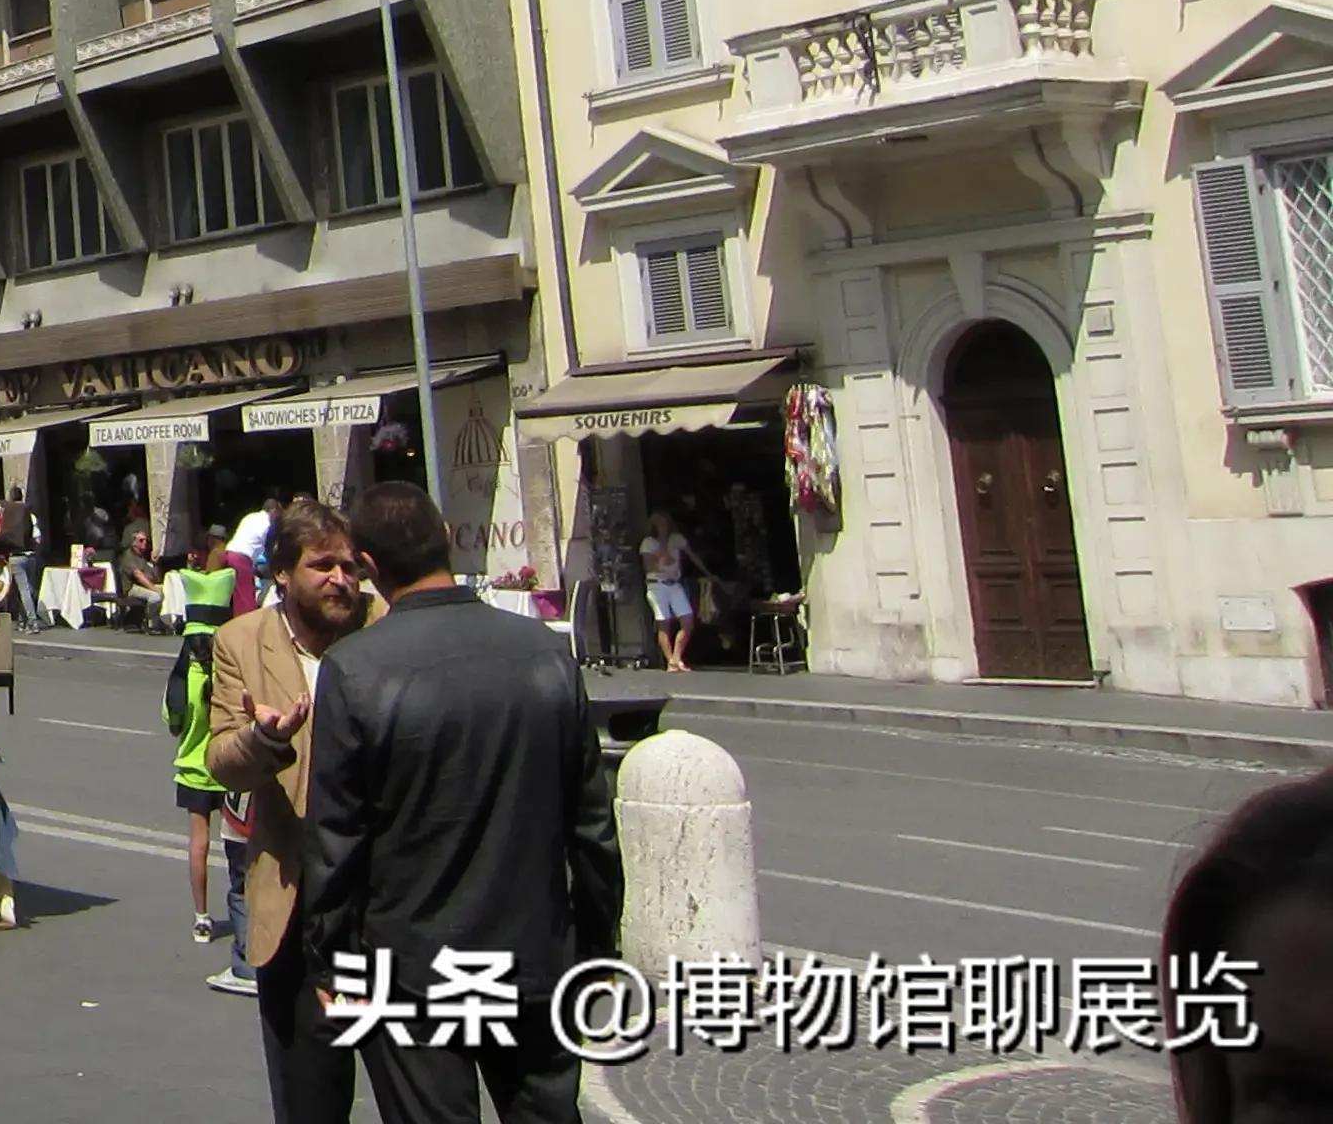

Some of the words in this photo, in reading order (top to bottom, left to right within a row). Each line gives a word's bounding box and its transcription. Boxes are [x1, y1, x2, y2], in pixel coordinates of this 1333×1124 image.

[60, 341, 299, 399] VATICANO
[248, 408, 318, 426] SANDWICHES
[319, 405, 341, 422] HOT
[343, 403, 375, 420] PIZZA
[574, 409, 672, 430] SOUVENIRS
[95, 427, 112, 442] TEA
[114, 426, 134, 442] AND
[136, 424, 172, 440] COFFEE
[172, 423, 202, 438] ROOM
